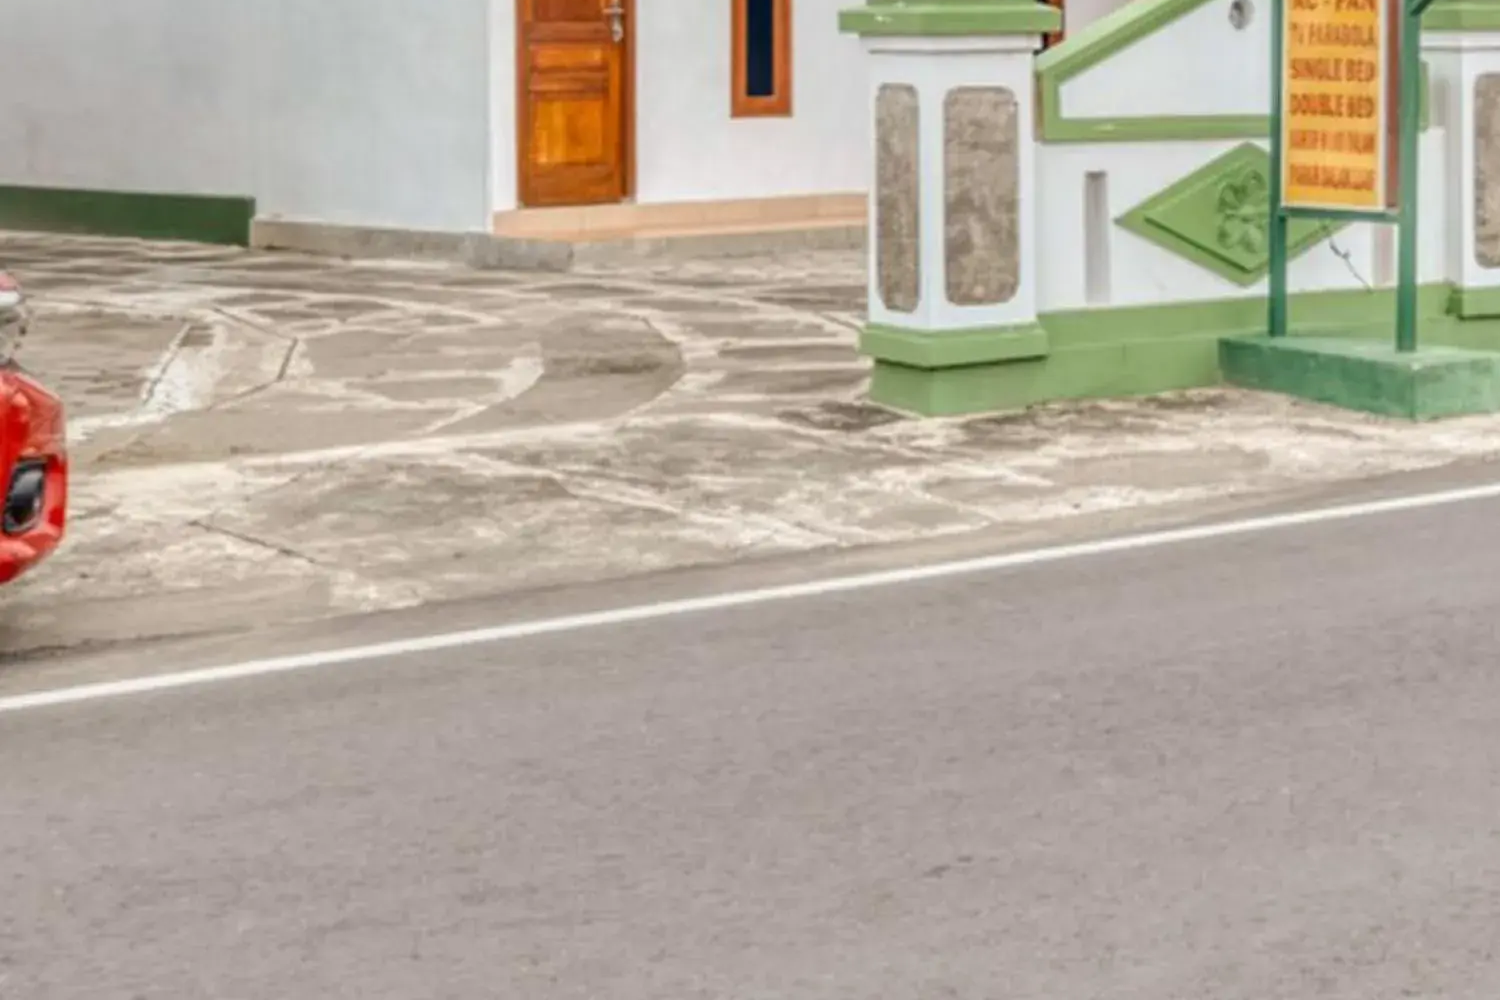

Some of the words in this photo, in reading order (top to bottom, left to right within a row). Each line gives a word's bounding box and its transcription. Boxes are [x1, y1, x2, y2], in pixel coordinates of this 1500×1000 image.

[1290, 57, 1342, 81] SINGLE
[1346, 58, 1375, 82] BED
[1290, 93, 1343, 117] DOUBLE
[1347, 95, 1375, 118] BED
